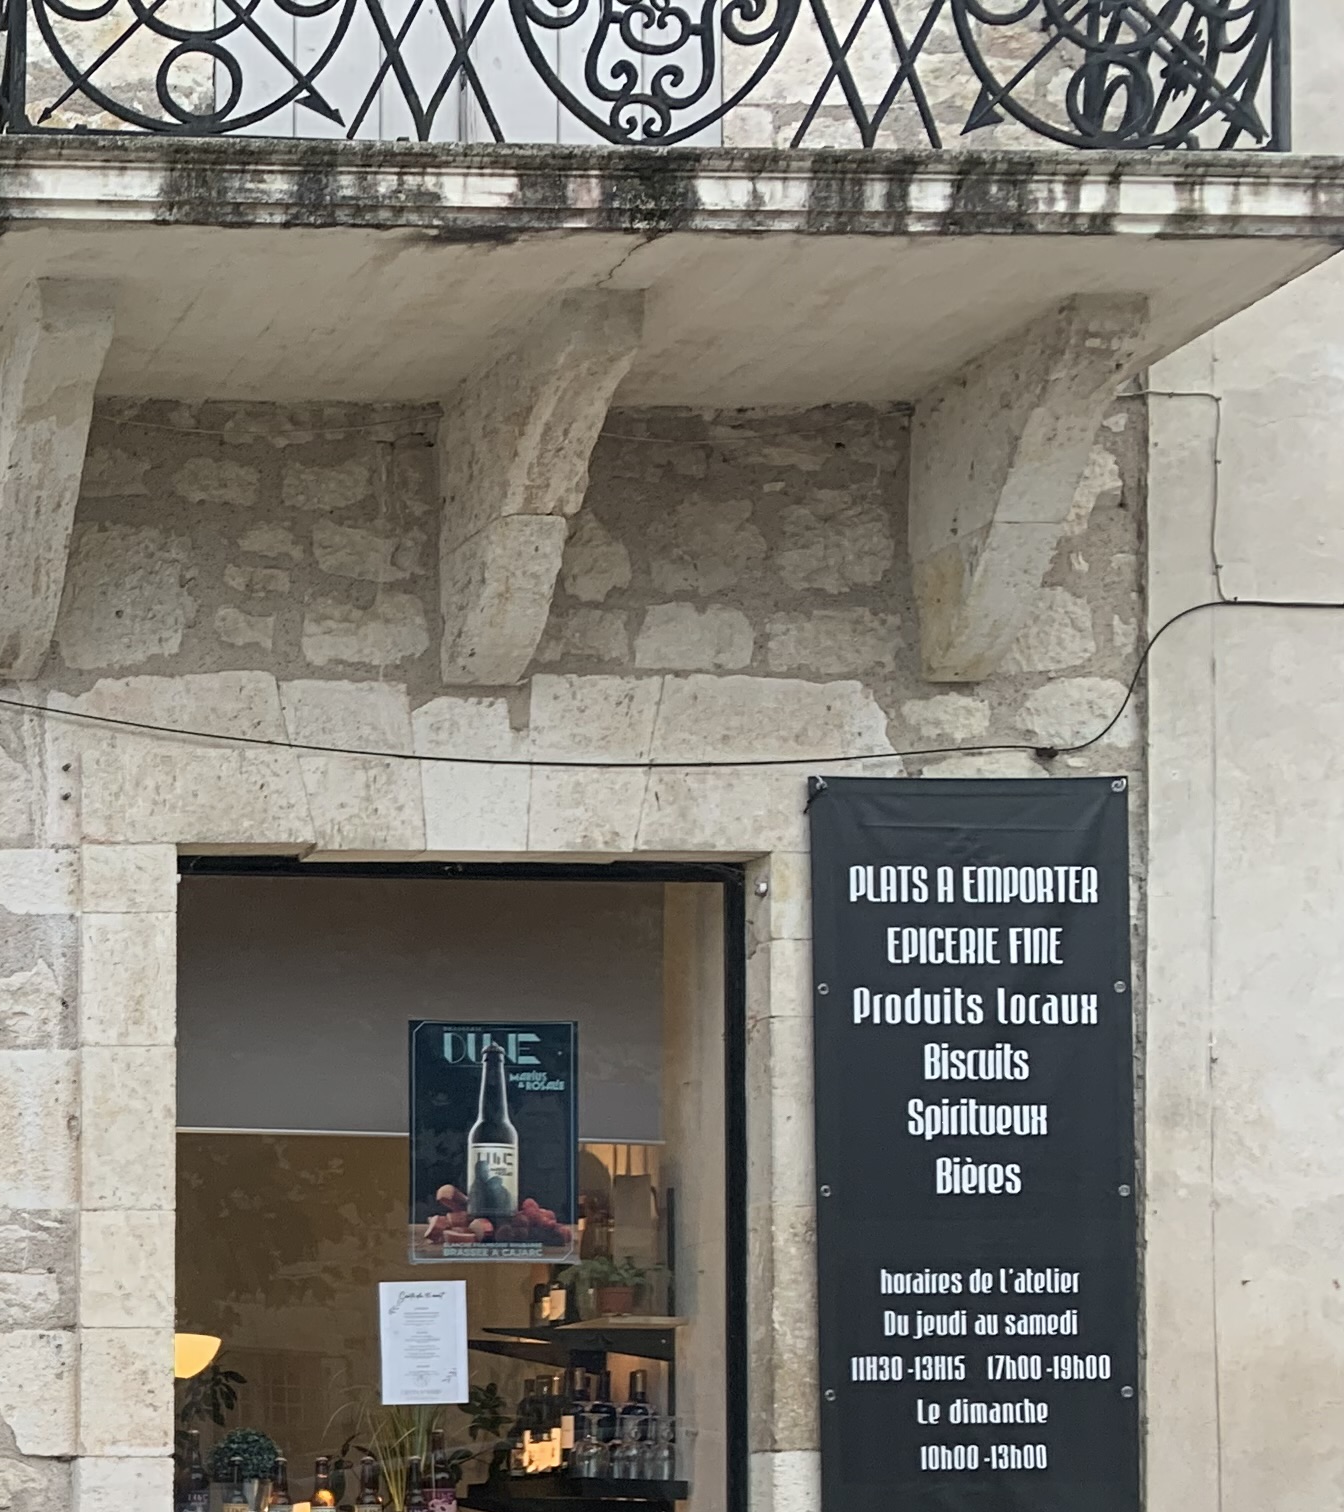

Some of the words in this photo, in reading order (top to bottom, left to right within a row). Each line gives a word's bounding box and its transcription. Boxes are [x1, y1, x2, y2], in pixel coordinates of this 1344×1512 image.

[850, 866, 928, 902] PLATS
[937, 866, 953, 902] A
[963, 867, 1097, 903] EMPORTER
[888, 927, 1000, 964] EPICERIE
[1009, 928, 1063, 964] FINE
[854, 988, 983, 1024] Produits
[998, 988, 1097, 1024] locaux
[925, 1043, 1029, 1080] Biscuits
[908, 1099, 1047, 1140] Spiritueux
[936, 1158, 1021, 1194] Bières
[881, 1269, 962, 1293] horaires
[970, 1269, 992, 1293] de
[1000, 1268, 1079, 1293] l'atelier
[885, 1311, 909, 1335] Du
[913, 1311, 966, 1339] jeudi
[975, 1315, 998, 1335] au
[1005, 1310, 1077, 1335] samedi
[852, 1356, 902, 1380] 11H30
[988, 1355, 1041, 1379] 17h00
[918, 1399, 940, 1424] Le
[950, 1399, 1047, 1423] dimanche
[921, 1445, 978, 1469] 10h00
